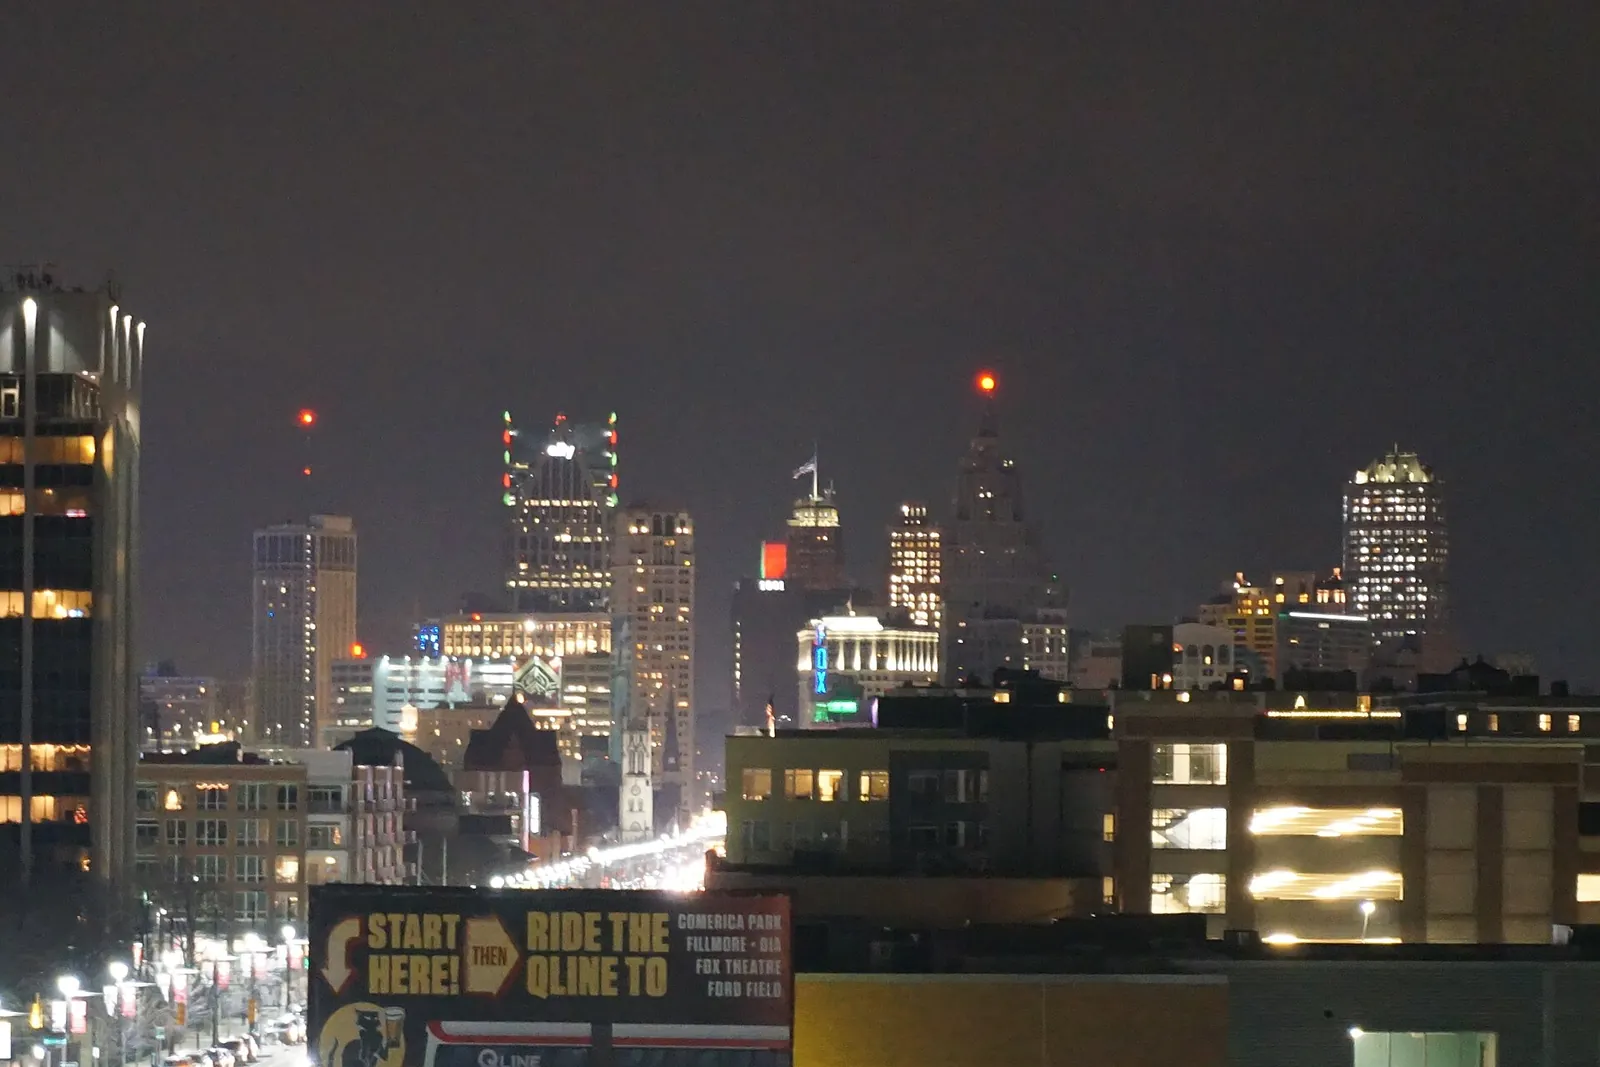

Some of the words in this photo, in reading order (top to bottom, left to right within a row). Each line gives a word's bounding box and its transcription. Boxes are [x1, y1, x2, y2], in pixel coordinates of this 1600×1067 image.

[368, 912, 460, 949] START
[527, 911, 602, 950] RIDE
[608, 912, 669, 952] THE
[678, 913, 744, 930] COMERICA
[748, 914, 782, 930] PARK
[686, 936, 747, 952] FILLMORE
[473, 946, 507, 966] THEN
[368, 954, 460, 994] HERE!
[527, 955, 618, 999] QLINE
[625, 956, 668, 997] TO
[696, 959, 720, 975] FOX
[725, 959, 782, 975] THEATRE
[708, 981, 741, 997] FORD
[746, 981, 782, 998] FIELD
